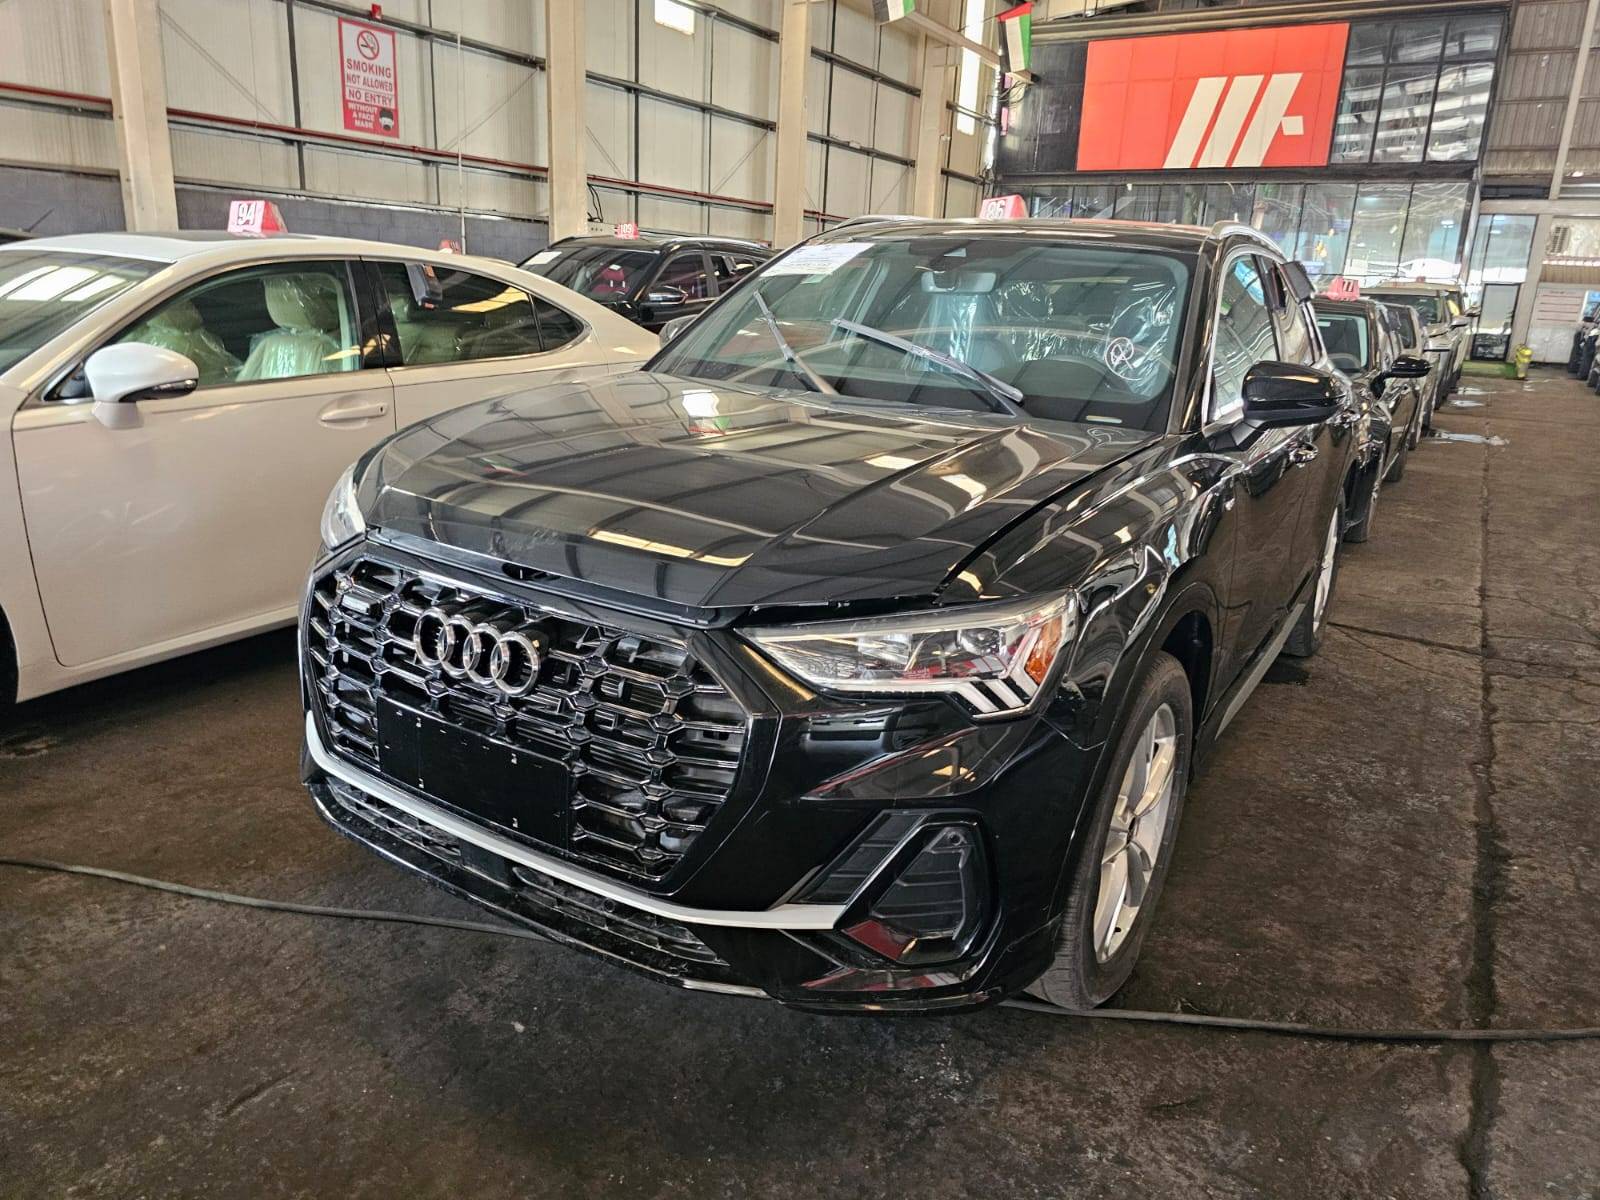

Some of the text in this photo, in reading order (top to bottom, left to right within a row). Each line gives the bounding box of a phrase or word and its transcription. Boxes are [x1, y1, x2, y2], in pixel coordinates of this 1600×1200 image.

[346, 58, 392, 79] SMOKING
[346, 73, 393, 93] NOT ALLOWED
[348, 89, 393, 107] NO ENTRY
[347, 102, 378, 115] WITHOUT
[237, 203, 257, 226] 94
